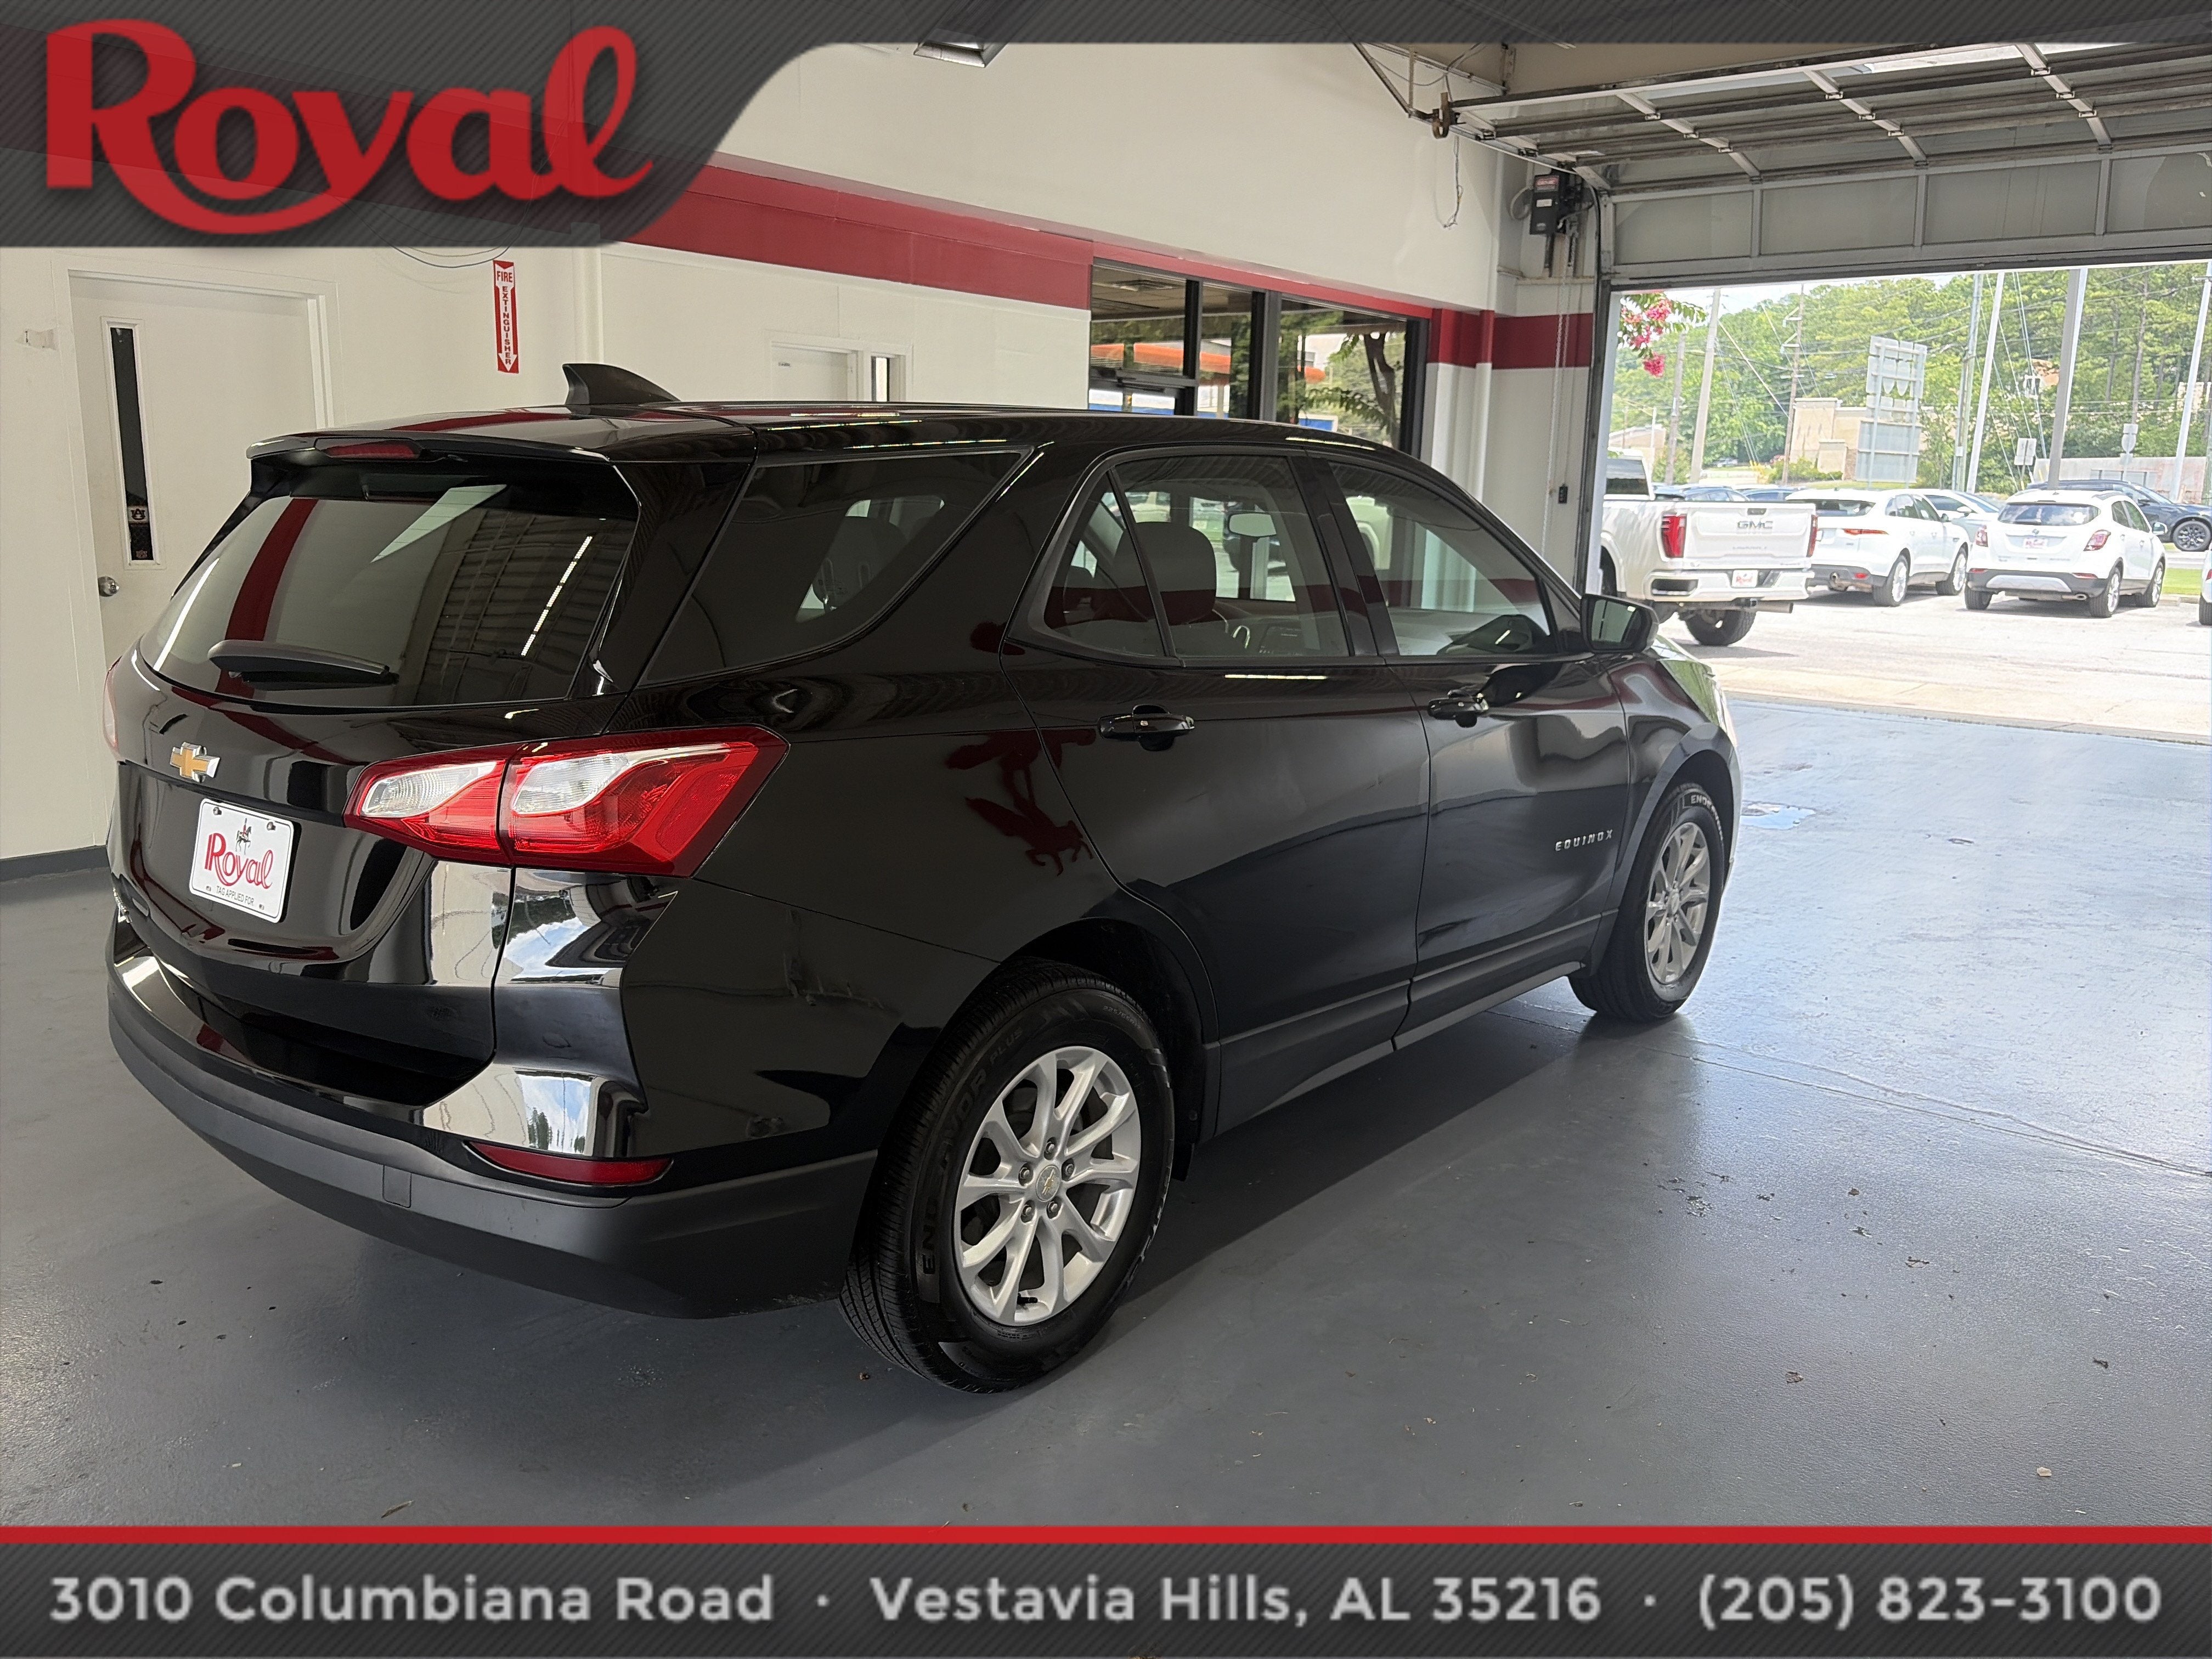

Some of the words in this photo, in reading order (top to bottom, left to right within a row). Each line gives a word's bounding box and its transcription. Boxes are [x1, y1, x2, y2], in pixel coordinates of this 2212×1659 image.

[497, 271, 513, 283] FIRE
[502, 286, 511, 365] EXTINGUISHER
[1737, 520, 1773, 529] GMC
[1555, 829, 1613, 851] EQUINOX
[205, 832, 273, 889] Royal
[216, 885, 225, 896] TAG
[225, 889, 244, 902] APPLIED
[245, 895, 254, 906] FOR
